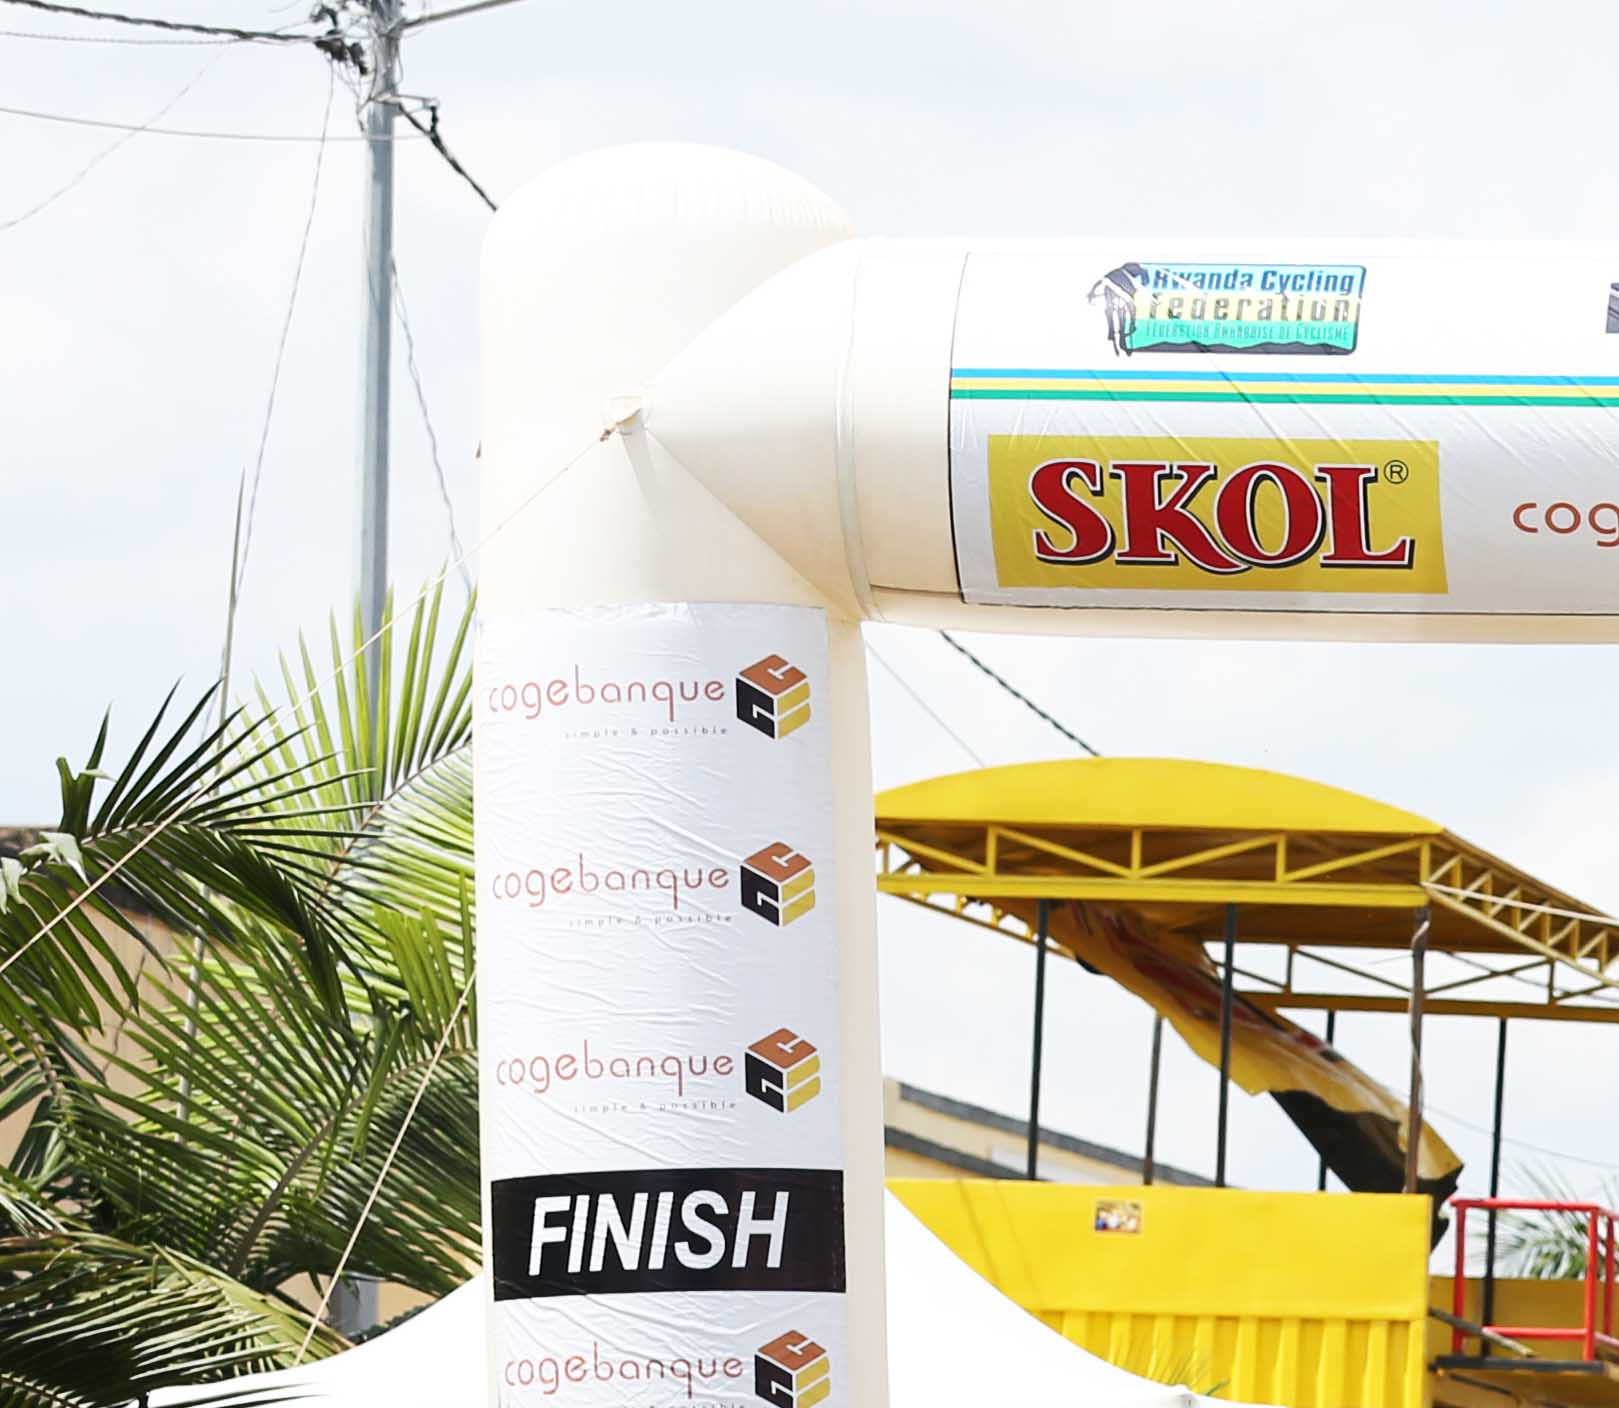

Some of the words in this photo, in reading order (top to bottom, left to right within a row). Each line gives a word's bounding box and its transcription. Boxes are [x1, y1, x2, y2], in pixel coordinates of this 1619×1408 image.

[1152, 269, 1254, 291] Rwanda
[1261, 270, 1355, 295] Cycling
[489, 663, 726, 722] cogebanque
[492, 853, 730, 911] cogebanque
[496, 1039, 735, 1097] cogebanque
[529, 1190, 789, 1276] FINISH
[504, 1340, 744, 1399] cogebanque
